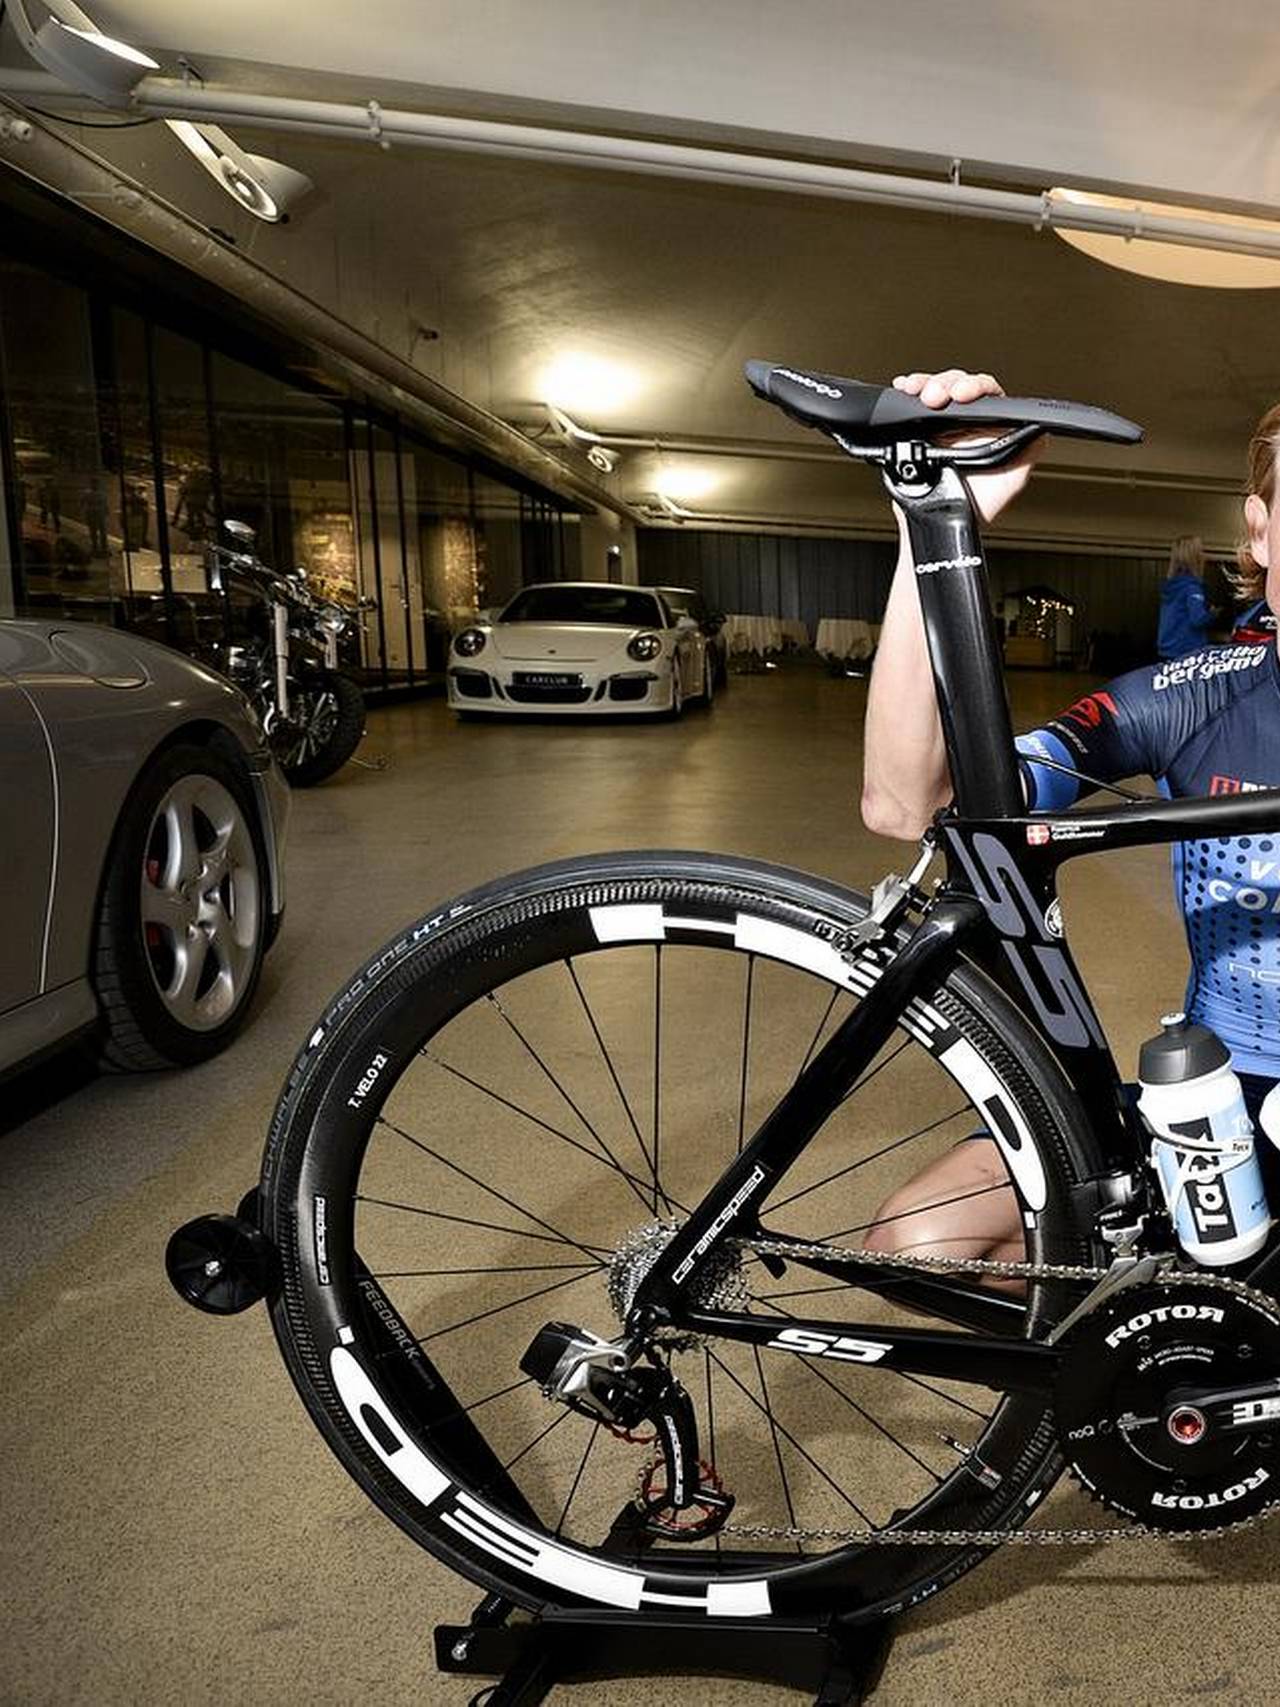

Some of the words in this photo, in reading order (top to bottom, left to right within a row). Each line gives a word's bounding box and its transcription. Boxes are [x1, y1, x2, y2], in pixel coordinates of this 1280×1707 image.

[671, 1166, 765, 1286] ceramicspeed
[357, 1279, 422, 1363] FEEDBACK
[767, 1327, 894, 1364] S5
